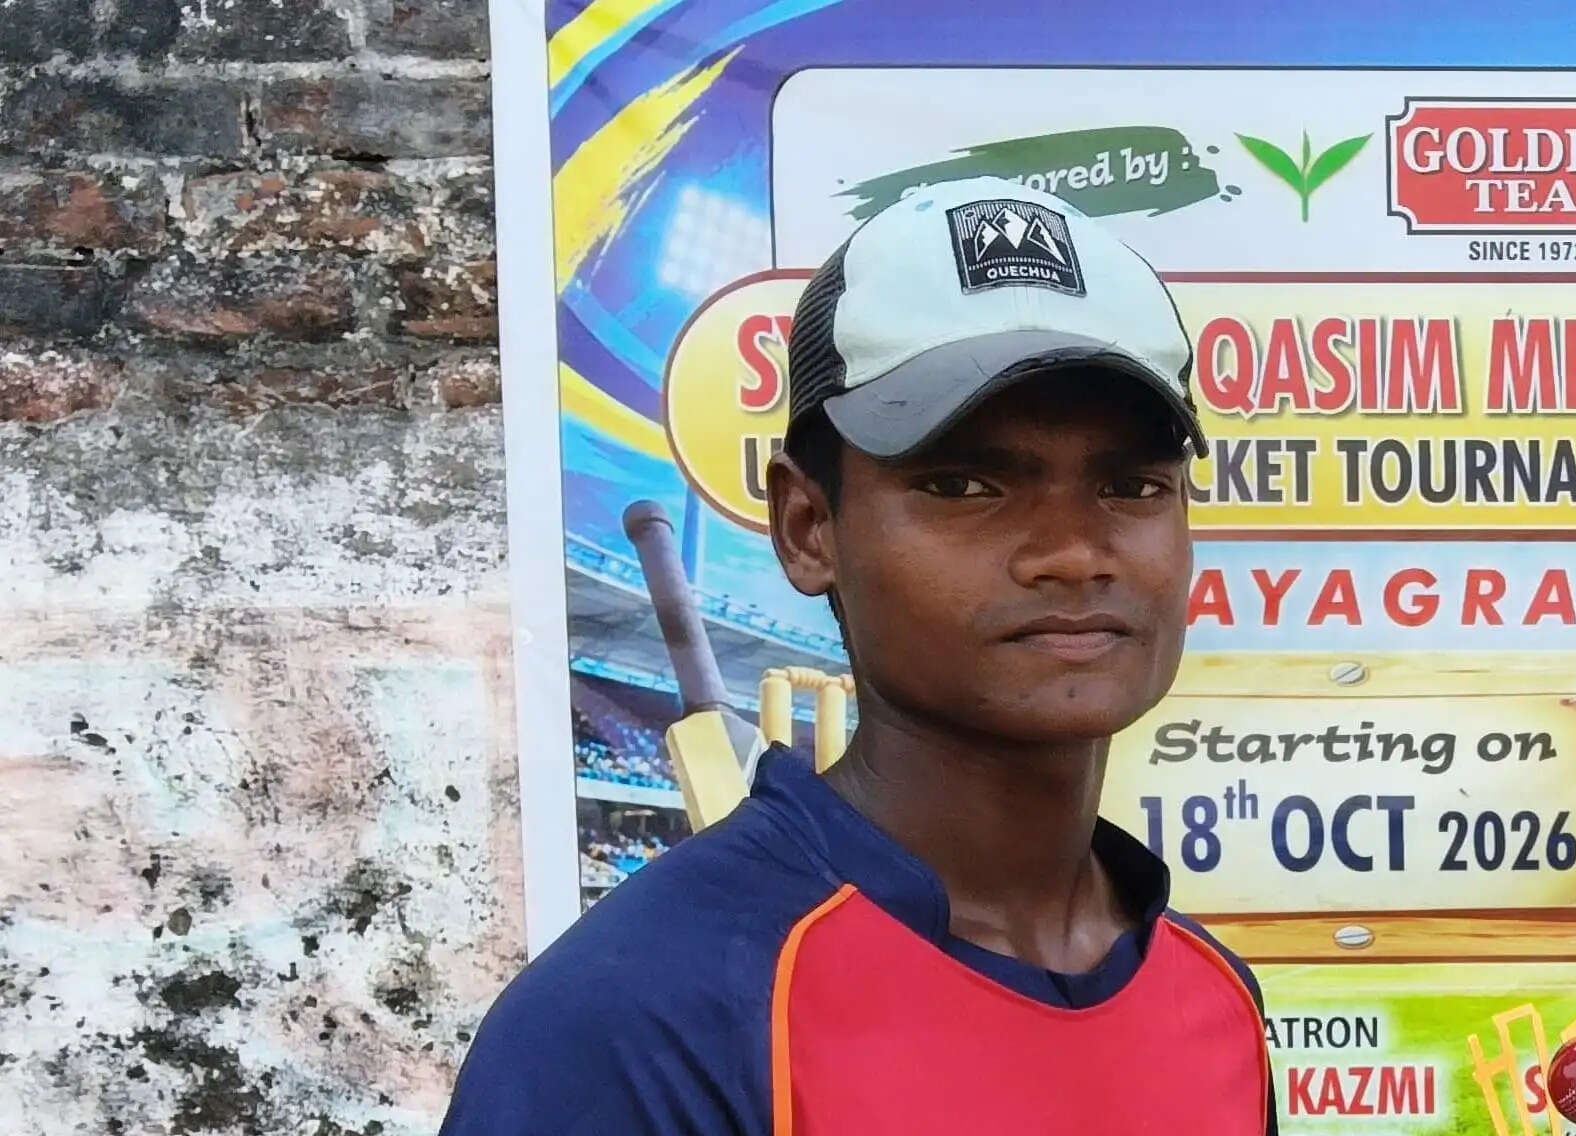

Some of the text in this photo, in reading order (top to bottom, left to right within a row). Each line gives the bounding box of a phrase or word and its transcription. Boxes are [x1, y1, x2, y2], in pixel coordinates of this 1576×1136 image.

[1120, 146, 1169, 184] by
[1468, 241, 1531, 262] SINCE
[1196, 317, 1458, 414] QASIM
[1182, 438, 1317, 503] CKET
[1149, 718, 1558, 775] Starting on
[1271, 795, 1415, 873] OCT
[1265, 1016, 1378, 1049] ATRON
[1288, 1066, 1435, 1115] KAZMI
